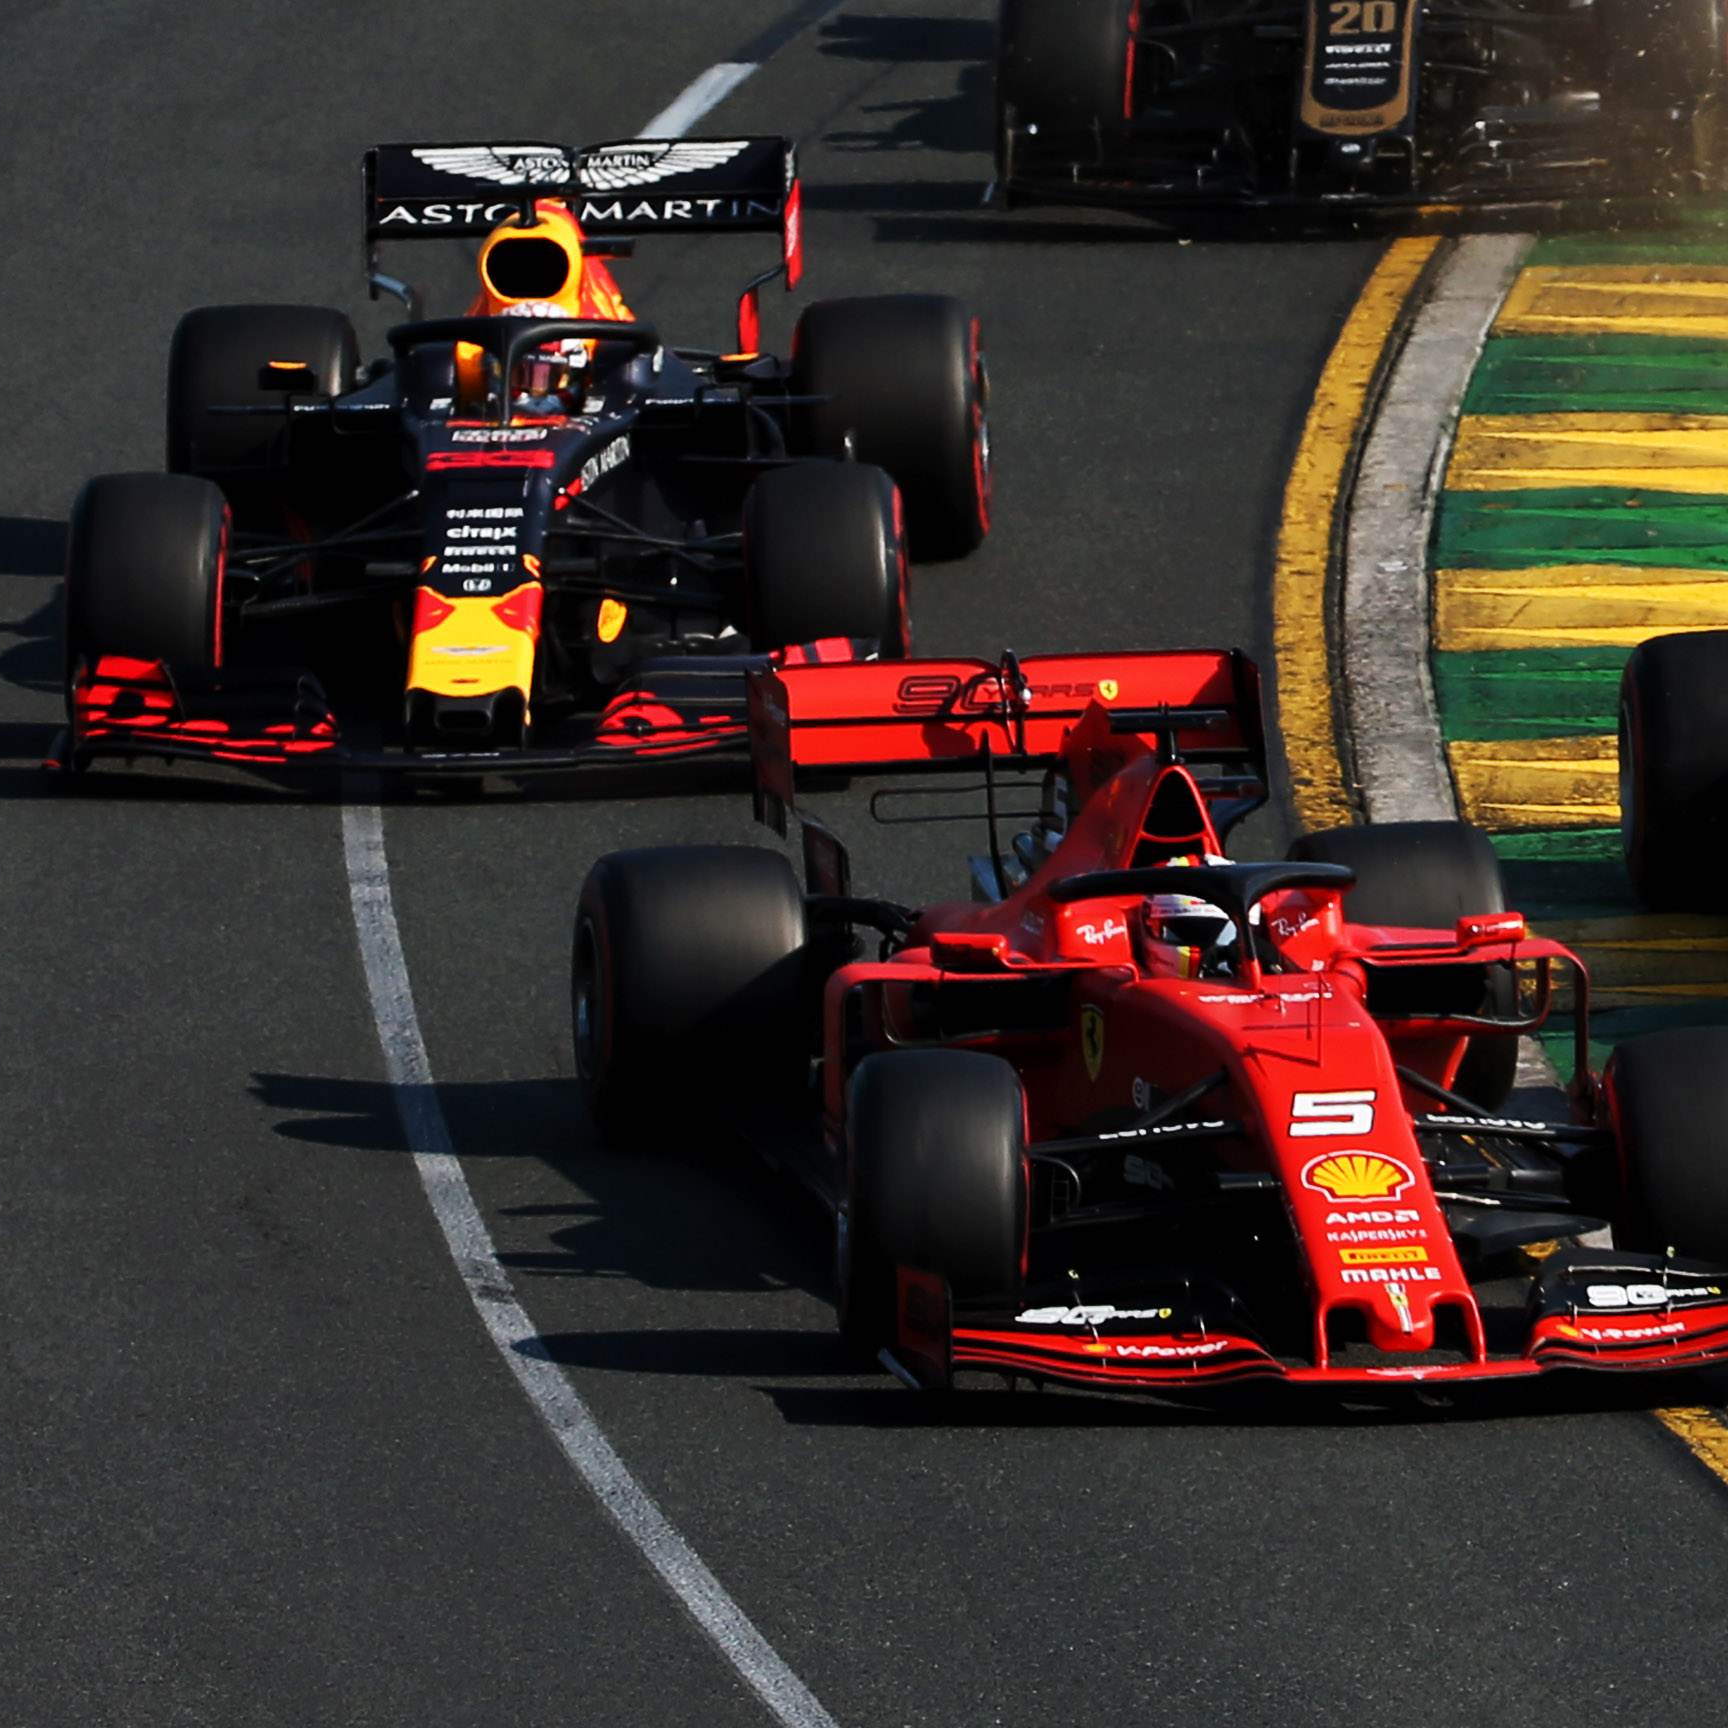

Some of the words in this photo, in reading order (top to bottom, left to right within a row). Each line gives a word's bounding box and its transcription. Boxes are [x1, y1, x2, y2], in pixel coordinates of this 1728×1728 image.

[1329, 0, 1396, 36] 20
[587, 153, 650, 169] MARTIN
[582, 198, 782, 222] MARTIN
[1288, 1089, 1376, 1138] 5
[1341, 1267, 1441, 1283] MAHLE
[1581, 1322, 1686, 1340] V-Power
[1116, 1341, 1228, 1356] V-Power
